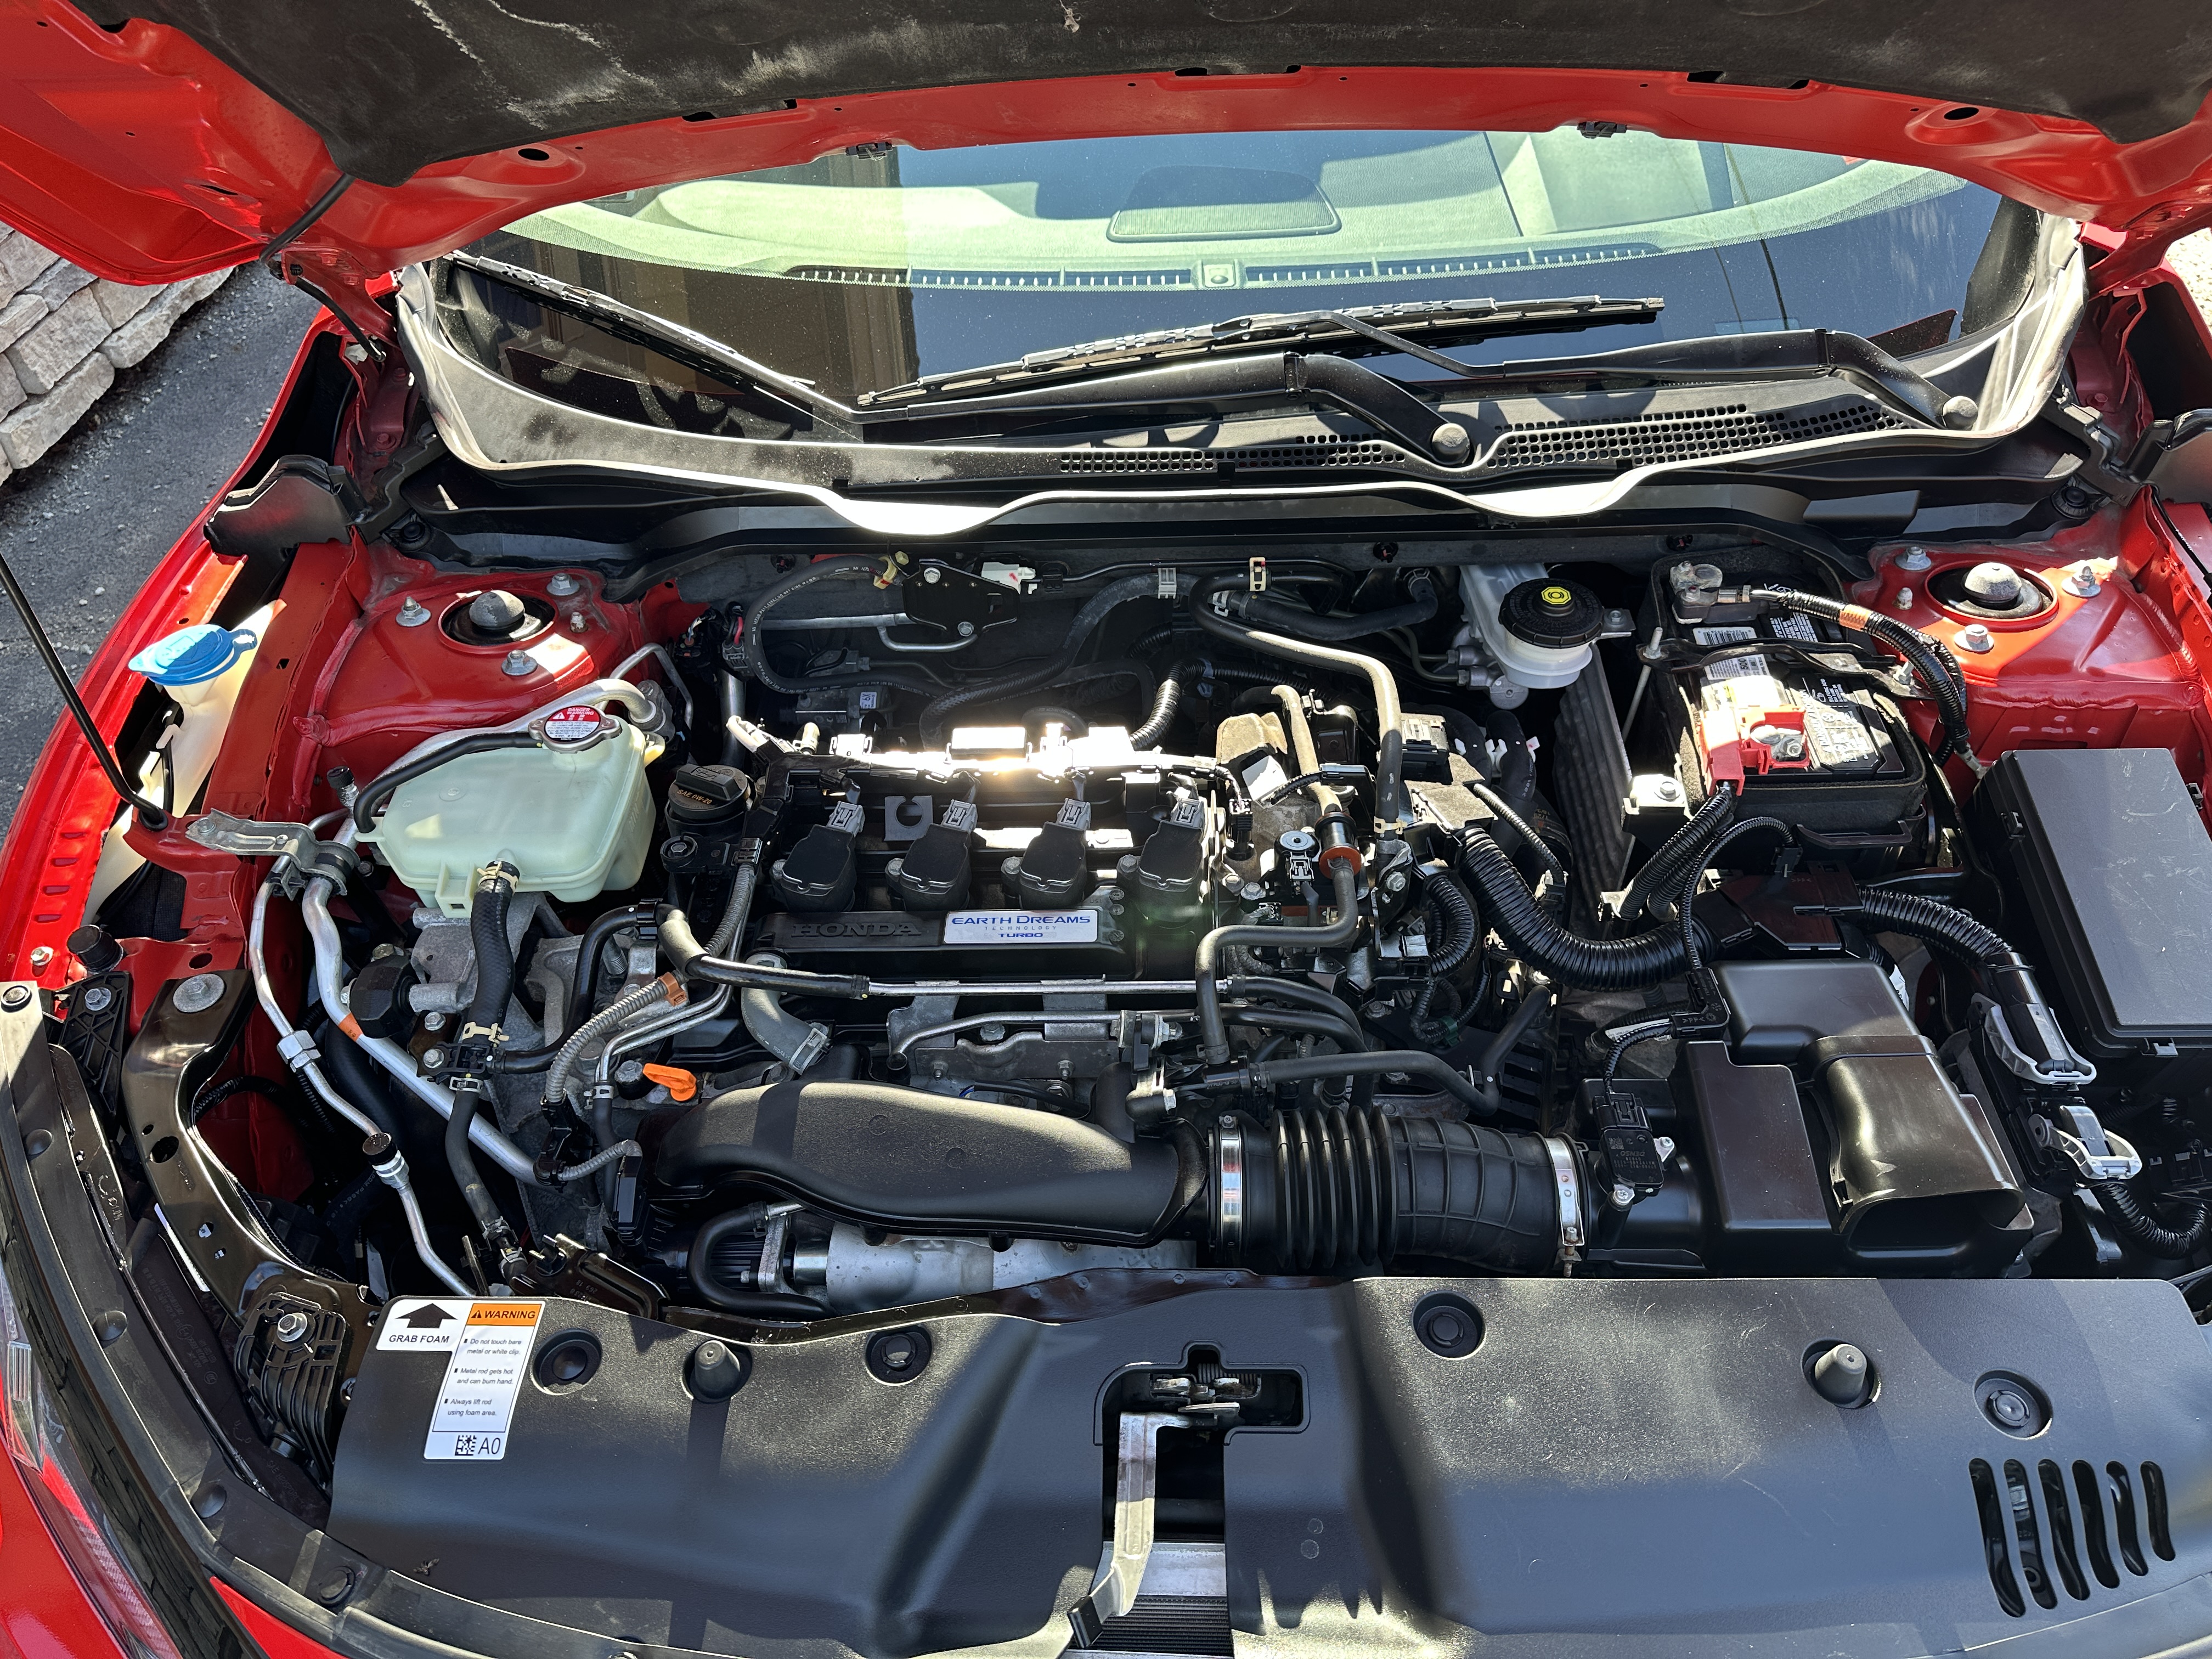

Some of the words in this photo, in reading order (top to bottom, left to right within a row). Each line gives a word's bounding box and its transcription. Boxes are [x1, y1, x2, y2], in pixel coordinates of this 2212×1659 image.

[677, 789, 692, 798] SAE
[692, 794, 713, 804] 0W-20
[1017, 915, 1091, 924] DREAMS
[791, 923, 922, 937] HONDA
[484, 1311, 535, 1319] WARNING
[389, 1335, 417, 1343] GRAB
[478, 1437, 500, 1455] A0
